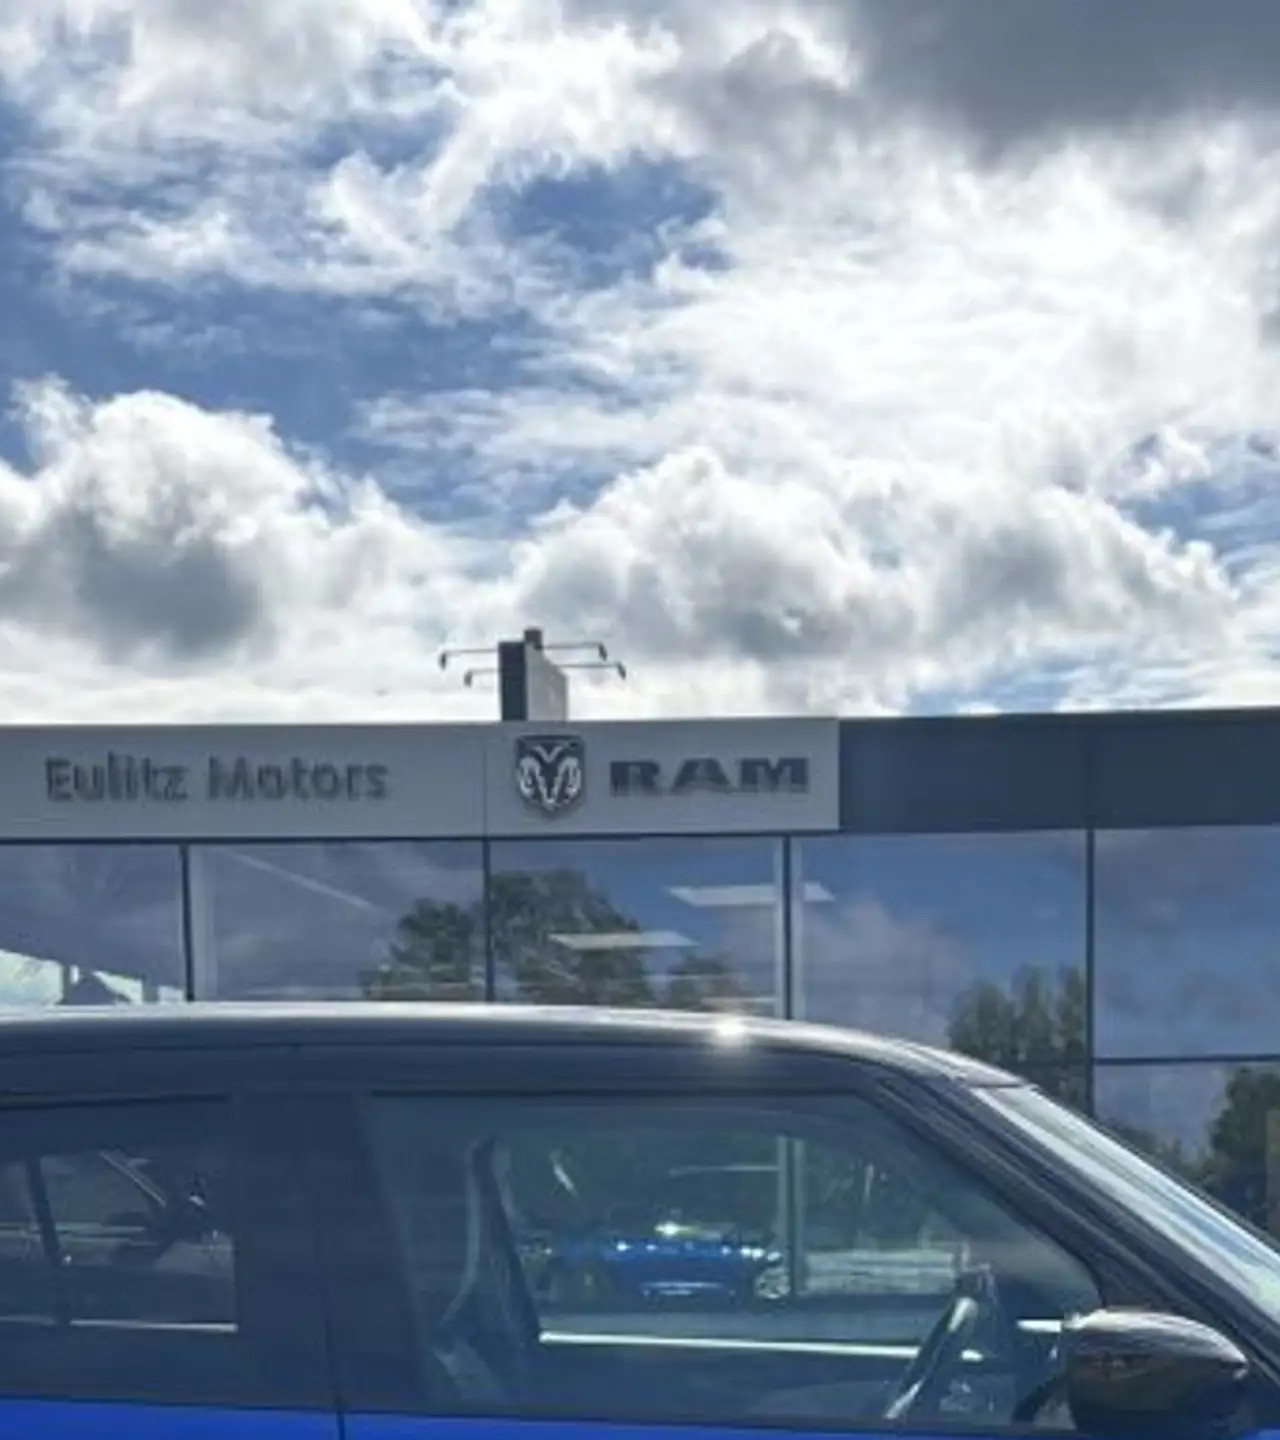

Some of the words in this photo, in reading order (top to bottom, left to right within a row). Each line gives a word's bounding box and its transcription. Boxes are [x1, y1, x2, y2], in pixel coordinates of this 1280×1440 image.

[45, 752, 190, 800] Eulitz
[208, 755, 389, 800] Motors
[609, 757, 810, 795] RAM
